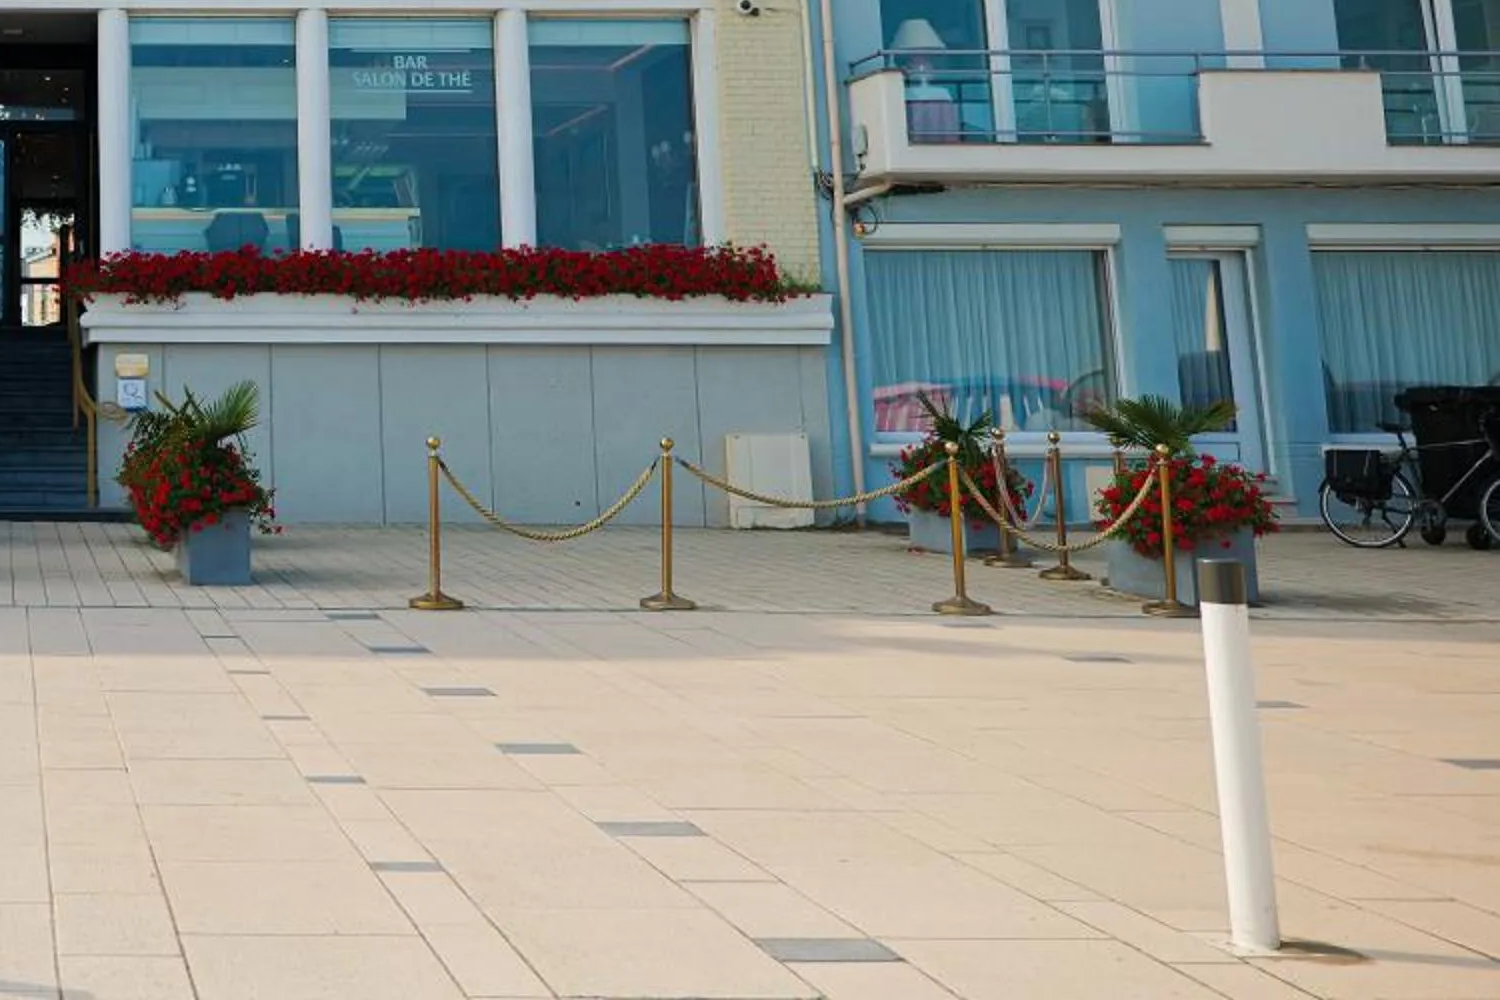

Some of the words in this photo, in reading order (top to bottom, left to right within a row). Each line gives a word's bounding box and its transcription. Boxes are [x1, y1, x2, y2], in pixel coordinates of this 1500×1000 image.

[393, 55, 428, 69] BAR
[353, 70, 406, 88] SALON
[411, 71, 434, 87] DE
